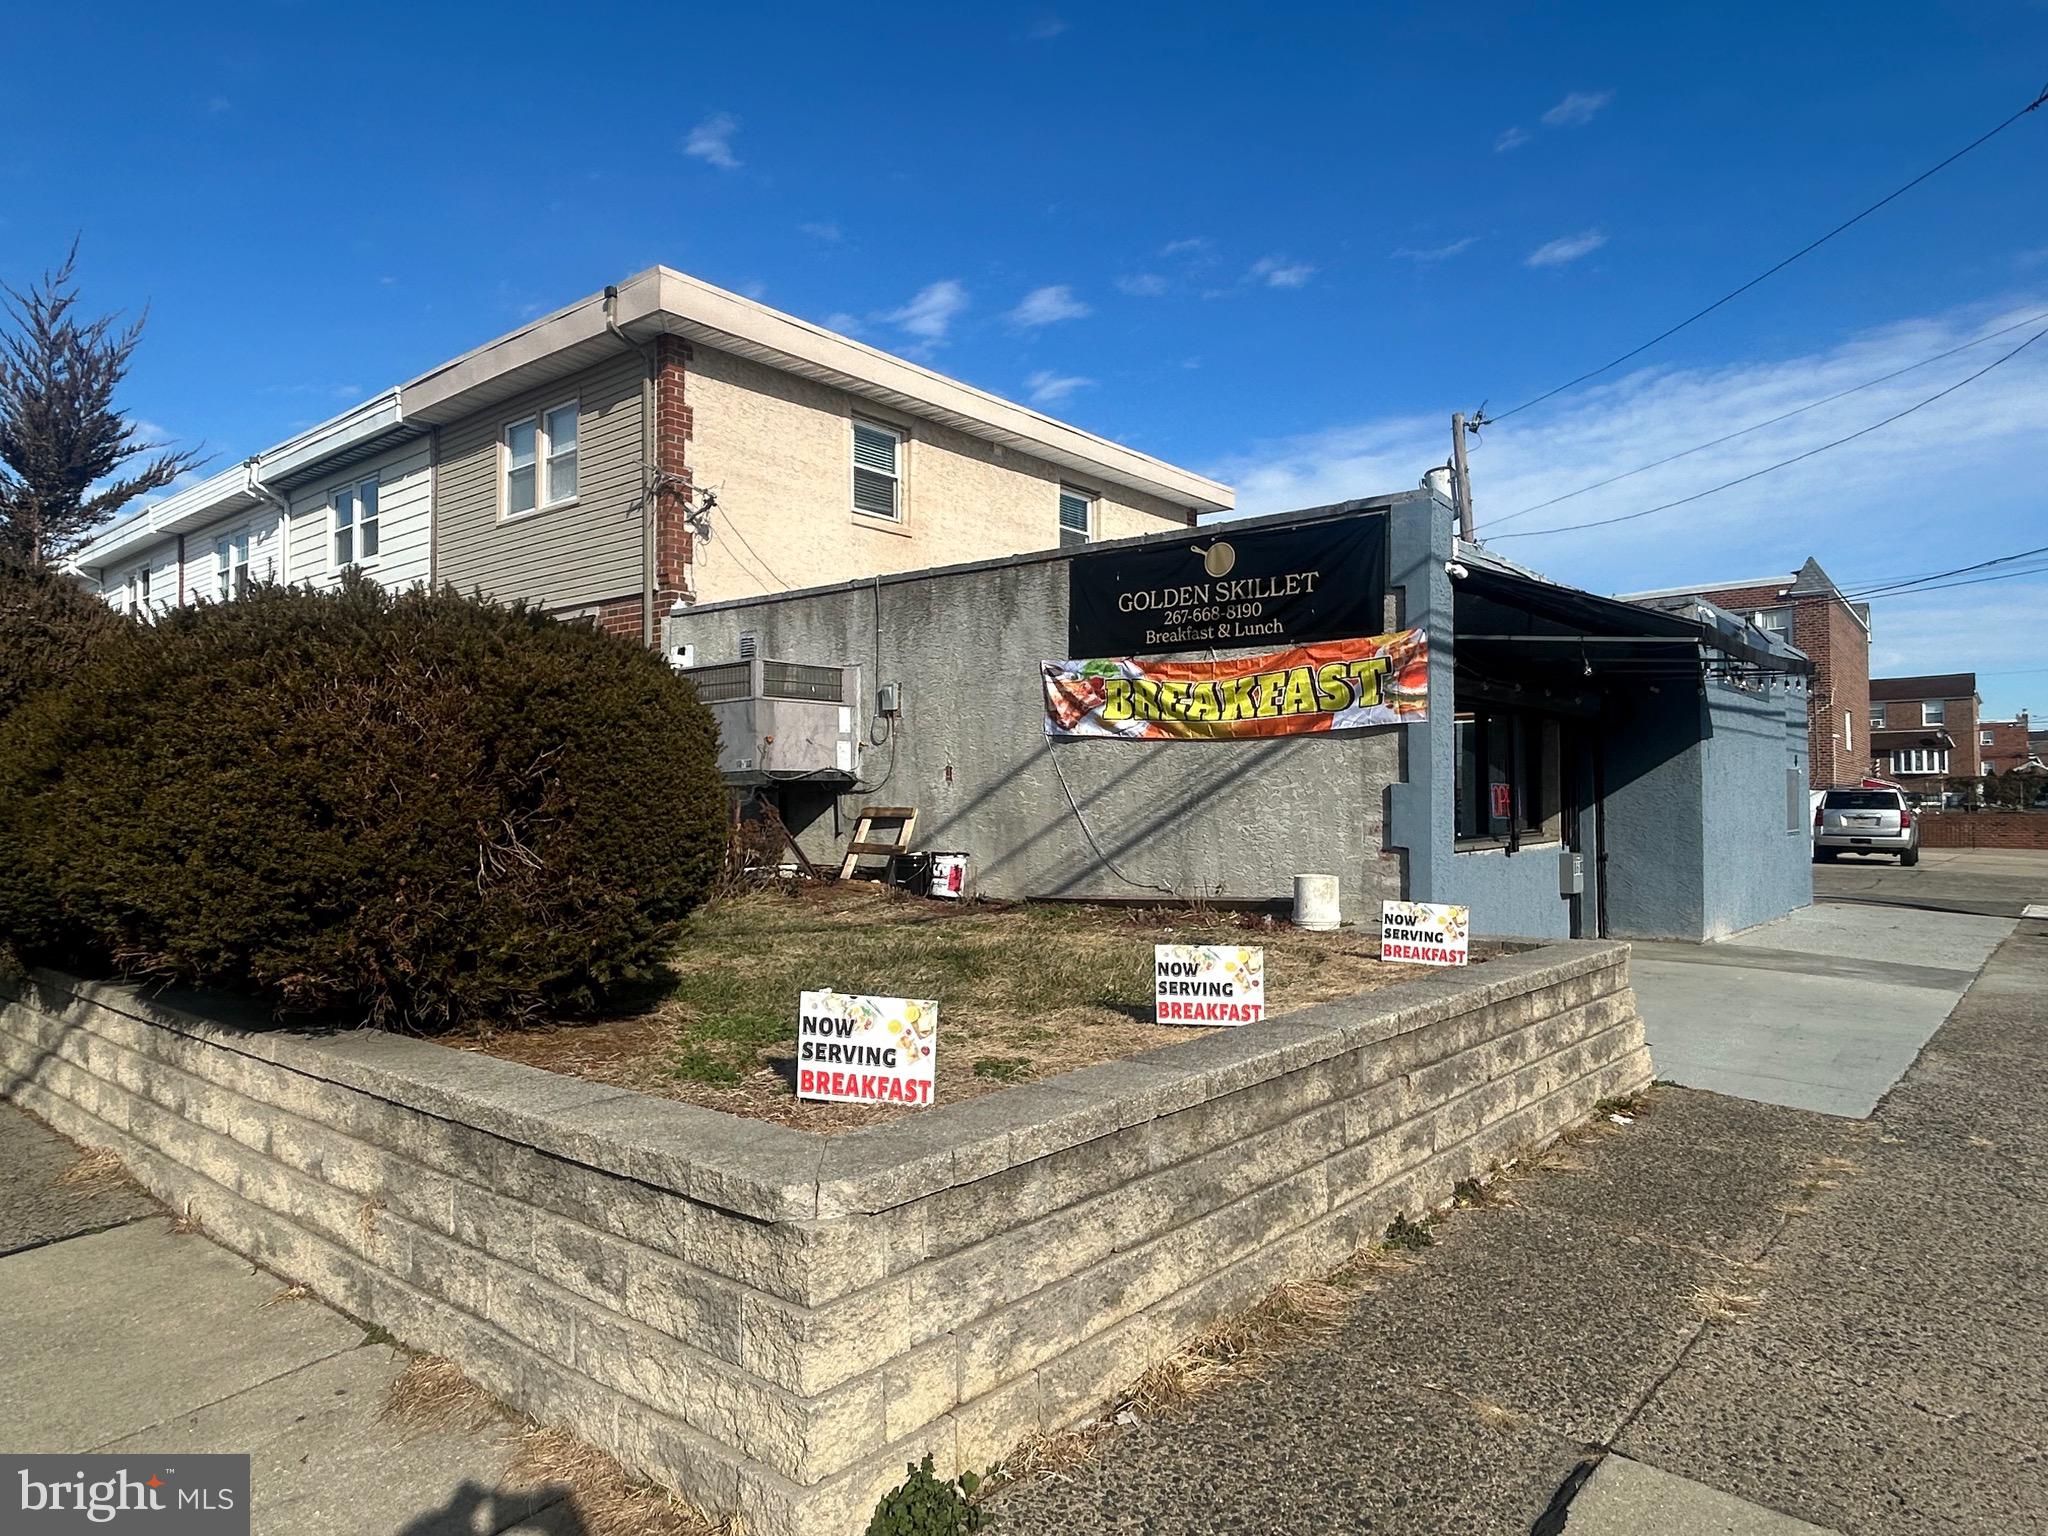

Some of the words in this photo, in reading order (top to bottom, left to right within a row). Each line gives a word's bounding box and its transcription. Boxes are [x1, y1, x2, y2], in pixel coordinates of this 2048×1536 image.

[1118, 584, 1210, 613] GOLDEN
[1215, 571, 1320, 602] SKILLET
[1163, 602, 1262, 626] 267-668-8190
[1145, 626, 1215, 645] Breakfast
[1217, 623, 1231, 638] &
[1234, 618, 1284, 637] Lunch
[1102, 656, 1393, 722] BREAKFAST
[1384, 913, 1418, 927] NOW
[1384, 927, 1444, 944] SERVING
[1383, 944, 1466, 964] BREAKFAST
[1157, 962, 1200, 978] NOW
[1158, 981, 1233, 998] SERVING
[1158, 1001, 1262, 1024] BREAKFAST
[802, 1015, 855, 1038] NOW
[801, 1041, 897, 1068] SERVING
[800, 1069, 932, 1103] BREAKFAST
